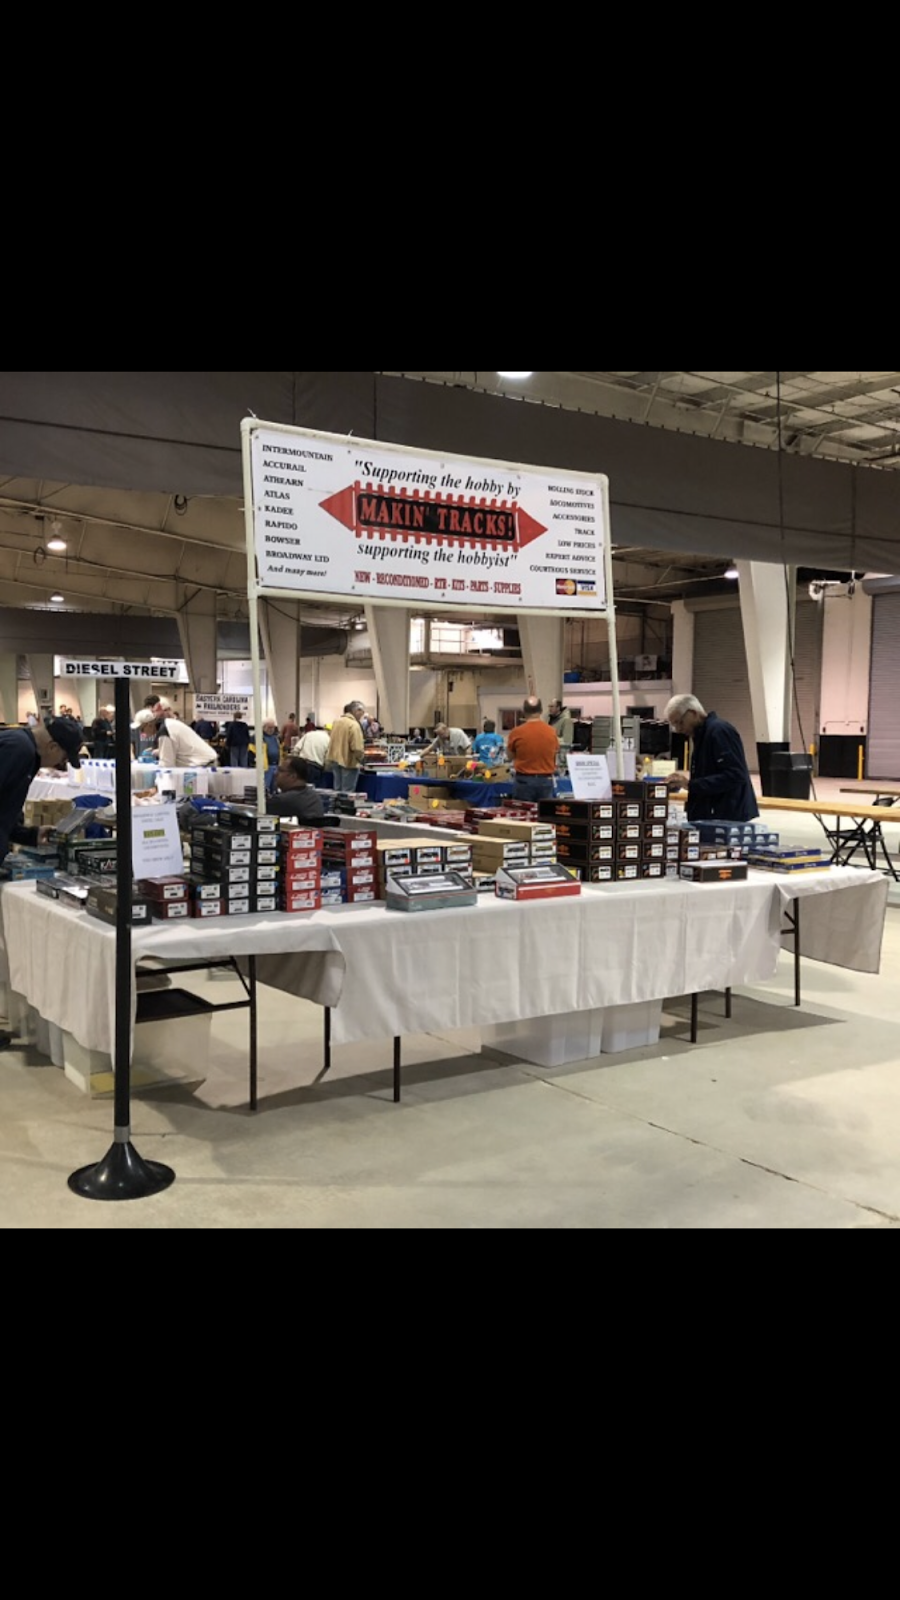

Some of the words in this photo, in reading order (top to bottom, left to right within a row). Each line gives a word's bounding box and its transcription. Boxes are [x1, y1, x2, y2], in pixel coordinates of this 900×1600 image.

[262, 444, 333, 461] INTERMOUNTAIN
[263, 460, 307, 472] ACCURAIL
[263, 475, 304, 487] ATHEARN
[355, 460, 438, 489] "Supporting
[440, 474, 462, 489] the
[465, 475, 504, 497] hobby
[507, 482, 521, 499] by
[264, 490, 290, 500] ATLAS
[548, 485, 574, 495] ROLLING
[576, 487, 595, 496] STOCK
[264, 505, 294, 515] KADEE
[550, 499, 595, 510] LOCOMOTIVES
[360, 498, 430, 527] MAKIN'
[437, 508, 513, 537] TRACKS!
[552, 513, 595, 523] ACCESSORIES
[265, 519, 298, 530] RAPIDO
[574, 528, 595, 536] TRACK
[265, 535, 301, 546] BOWSER
[573, 541, 596, 549] PRICES
[266, 550, 312, 561] BROADWAY
[315, 554, 330, 563] LTD
[357, 543, 430, 565] supporting
[433, 548, 454, 563] the
[457, 553, 518, 569] hobbyist"
[267, 564, 283, 573] And
[285, 568, 305, 577] many
[306, 569, 327, 577] more!
[530, 565, 568, 574] COURTEOUS
[570, 567, 596, 575] SERVICE
[354, 570, 371, 583] NEW
[376, 572, 429, 589] RECONDITIONED
[470, 580, 489, 593] PARTS
[493, 582, 521, 595] SUPPLIES
[66, 663, 118, 675] DIESEL
[123, 664, 176, 677] STREET
[223, 695, 248, 703] CAROLINA
